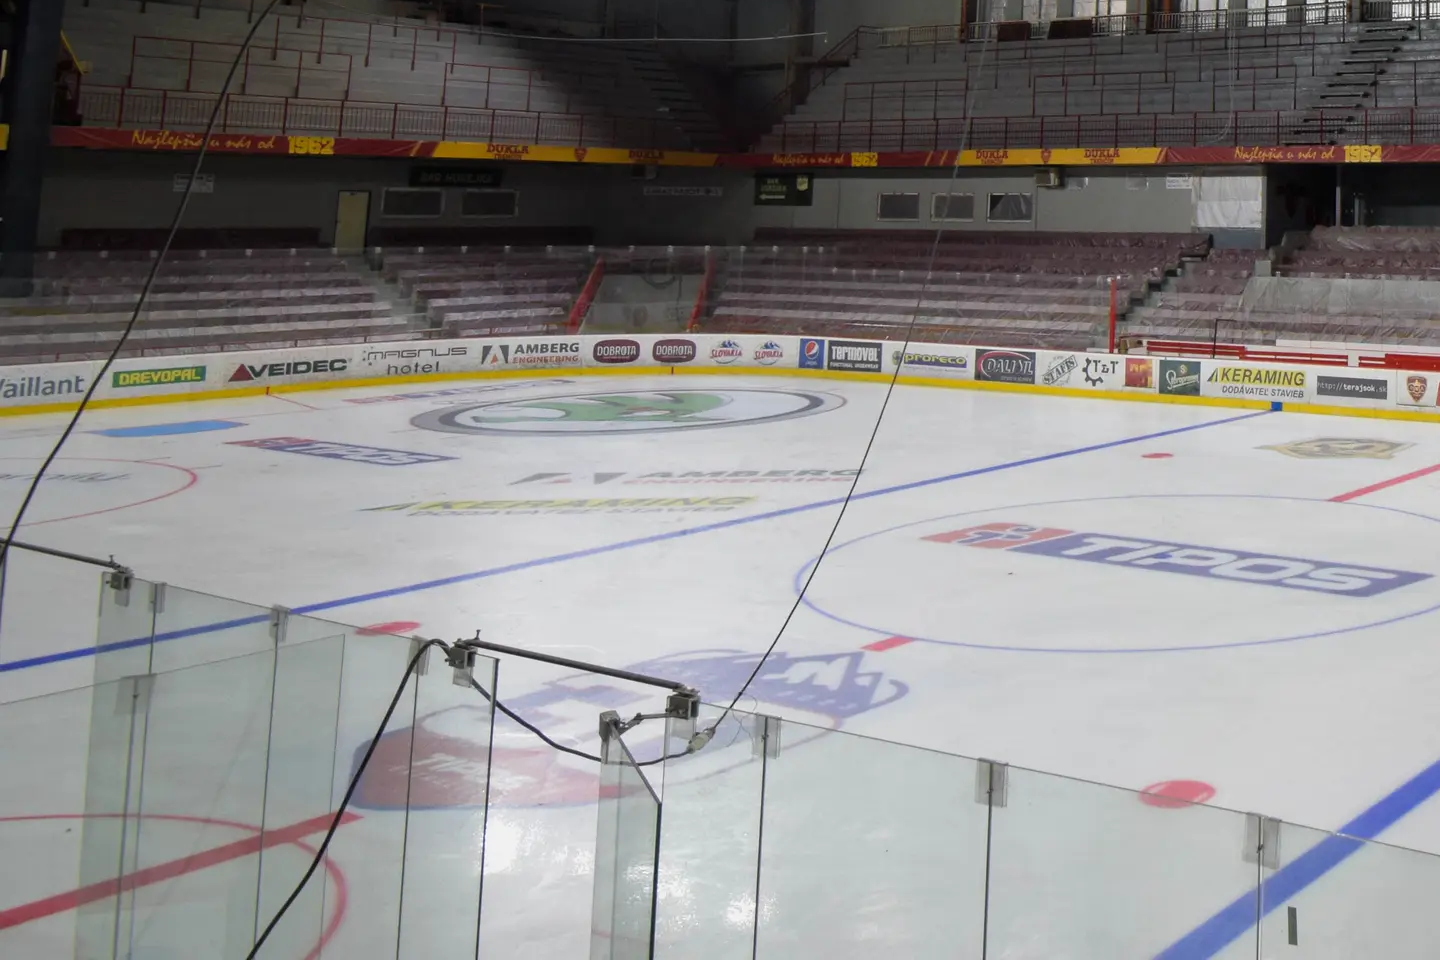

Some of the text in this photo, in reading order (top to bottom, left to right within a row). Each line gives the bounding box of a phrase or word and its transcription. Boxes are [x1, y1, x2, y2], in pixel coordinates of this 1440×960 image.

[287, 136, 337, 156] 1962
[486, 143, 529, 154] DUKLA
[1083, 148, 1120, 158] DUKLA
[1344, 144, 1382, 163] 1962
[975, 149, 1009, 159] DUKLA
[514, 342, 580, 355] AMBERG
[597, 345, 637, 356] DOBROTA
[655, 345, 693, 356] DOBROTA
[248, 358, 348, 378] VEIDEC
[387, 361, 440, 376] hotel
[118, 367, 202, 386] DREVOPAL
[1221, 367, 1306, 386] KERAMING
[0, 375, 85, 399] aillant
[1270, 388, 1304, 398] STAVIEB
[1061, 537, 1399, 592] TIPOS
